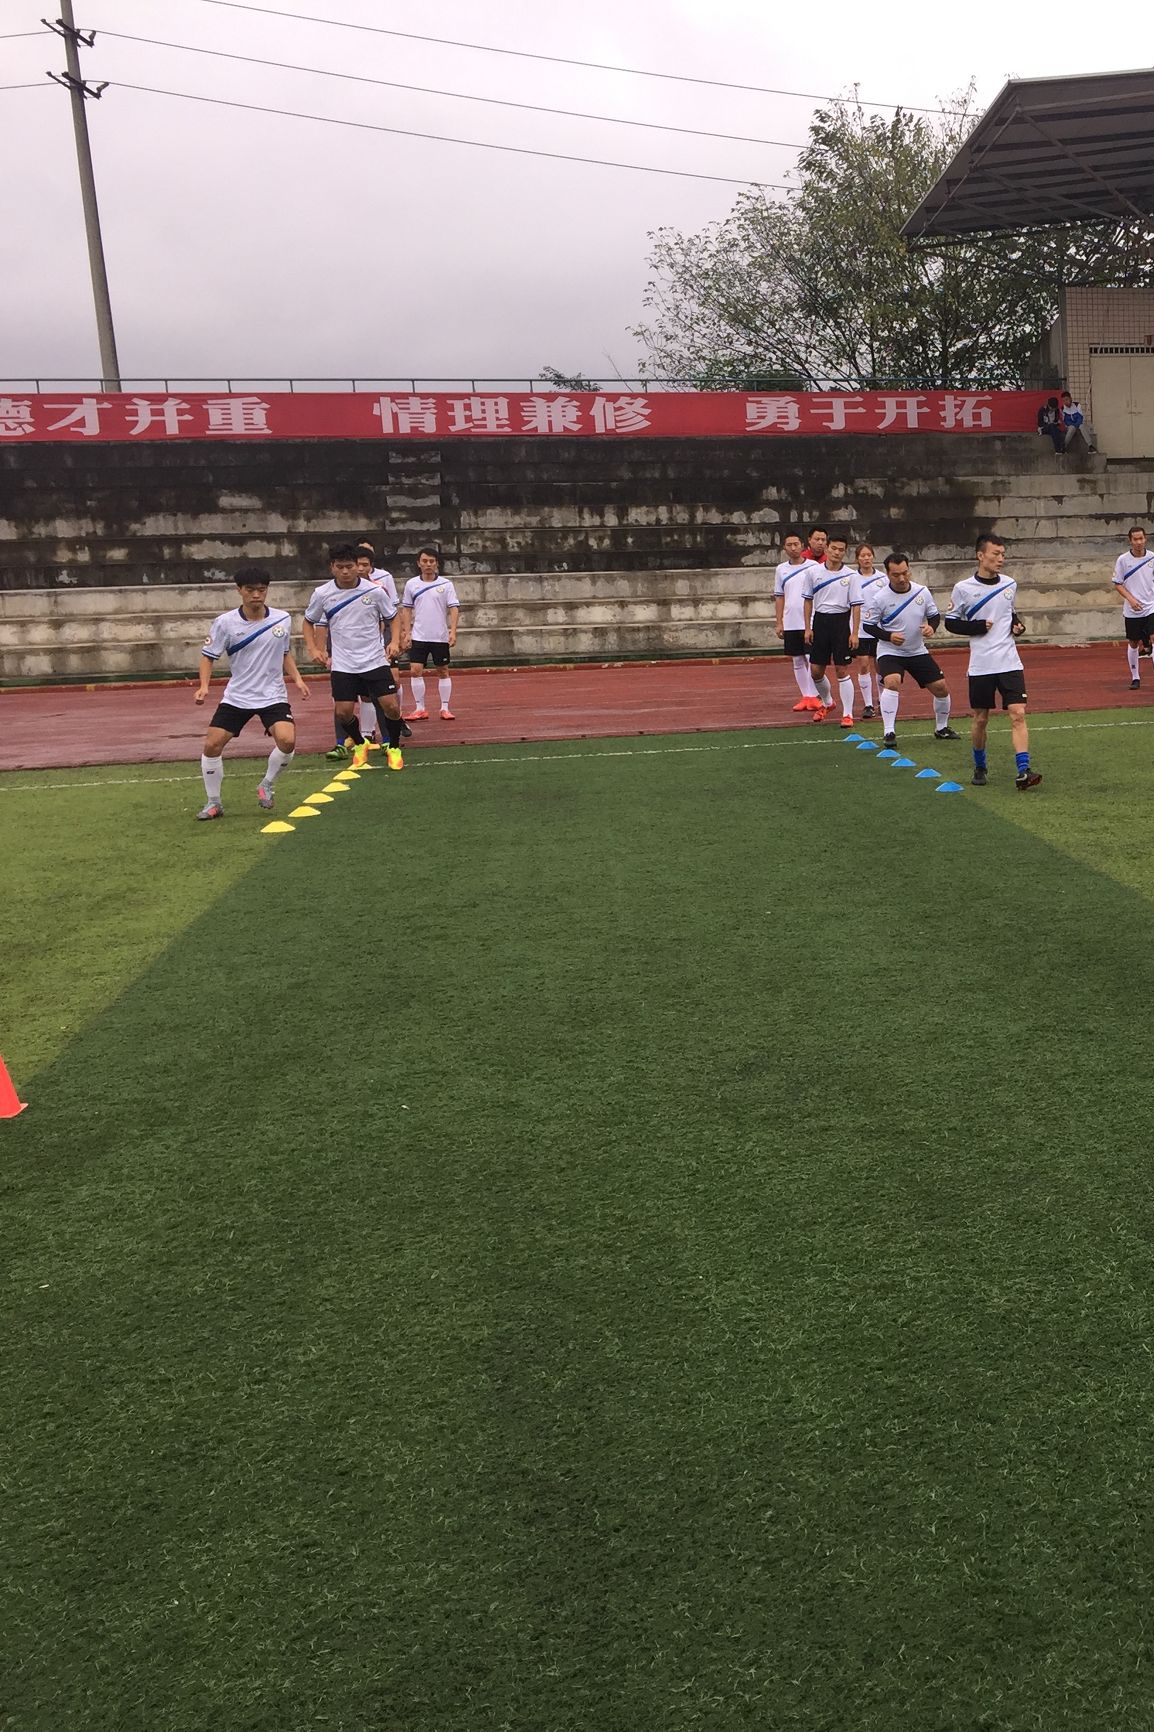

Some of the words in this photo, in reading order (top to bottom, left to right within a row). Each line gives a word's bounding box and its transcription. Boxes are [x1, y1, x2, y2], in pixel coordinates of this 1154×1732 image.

[373, 396, 652, 434] 情理兼修
[745, 395, 993, 432] 勇于开拓
